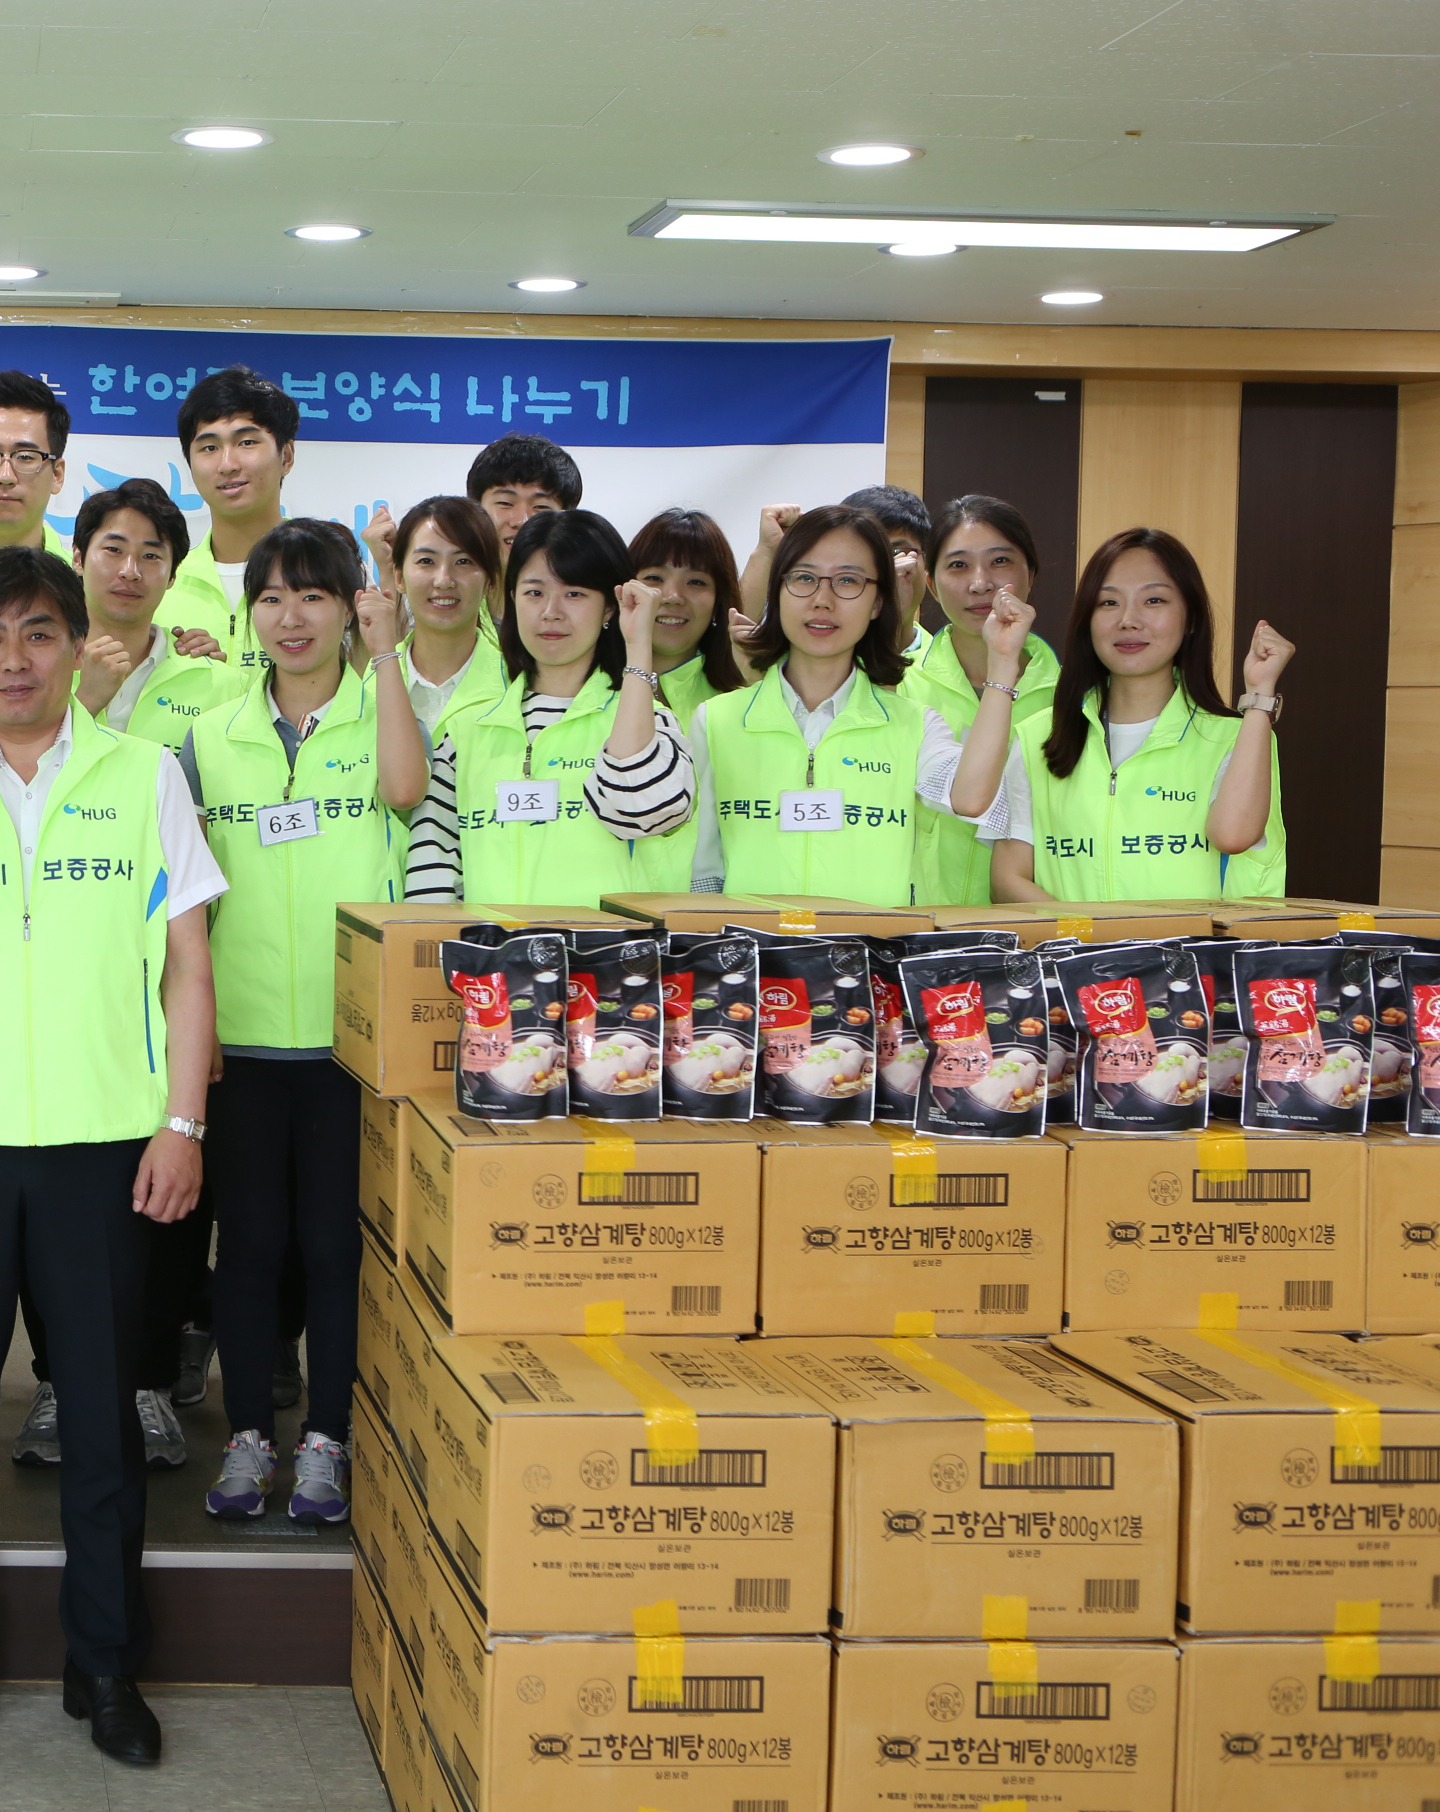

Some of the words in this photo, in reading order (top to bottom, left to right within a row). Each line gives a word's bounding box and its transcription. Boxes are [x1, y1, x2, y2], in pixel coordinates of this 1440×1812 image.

[466, 375, 630, 425] 나누기
[171, 704, 201, 717] HUG
[561, 758, 595, 770] HUG
[859, 760, 892, 774] HUG
[508, 792, 544, 812] 9조
[1162, 789, 1196, 803] HUG
[81, 807, 117, 821] HUG
[206, 803, 259, 827] 주택도
[720, 800, 780, 821] 주택도
[843, 804, 907, 828] 증공사
[793, 803, 831, 822] 5조
[269, 816, 307, 834] 6조
[43, 857, 135, 882] 보증공사
[765, 992, 789, 1006] 하림
[534, 1222, 646, 1247] 고향삼계탕
[845, 1226, 956, 1250] 고향삼계탕
[1149, 1221, 1259, 1246] 고향삼계탕
[580, 1505, 707, 1534] 고향삼계탕
[931, 1511, 1056, 1539] 고향삼계탕
[1282, 1503, 1405, 1531] 고향삼계탕
[578, 1733, 704, 1761] 고향삼계탕
[925, 1737, 1051, 1766] 고향삼계탕
[1269, 1733, 1394, 1760] 고향삼계탕
